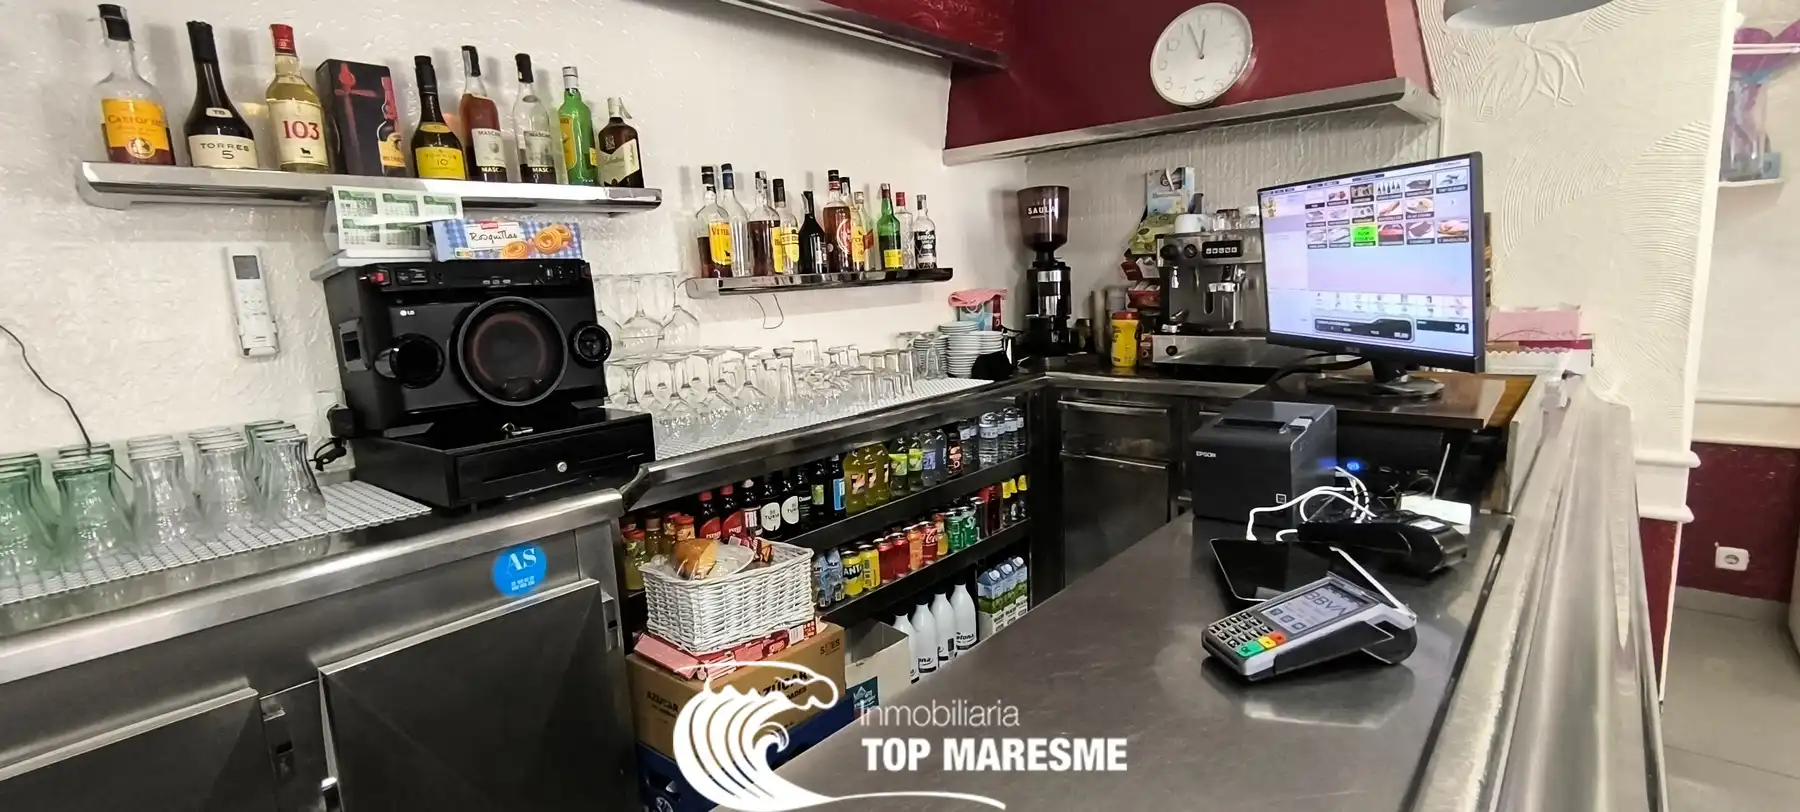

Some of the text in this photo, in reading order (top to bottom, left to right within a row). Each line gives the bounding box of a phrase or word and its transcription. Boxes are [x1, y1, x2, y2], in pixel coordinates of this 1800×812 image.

[282, 120, 320, 140] 103
[200, 142, 250, 152] TORRES
[222, 150, 235, 160] 5
[436, 158, 448, 166] 10
[468, 229, 518, 244] Rosquillas
[1454, 323, 1466, 332] 34
[1195, 450, 1217, 458] EPSON
[506, 547, 537, 574] AS
